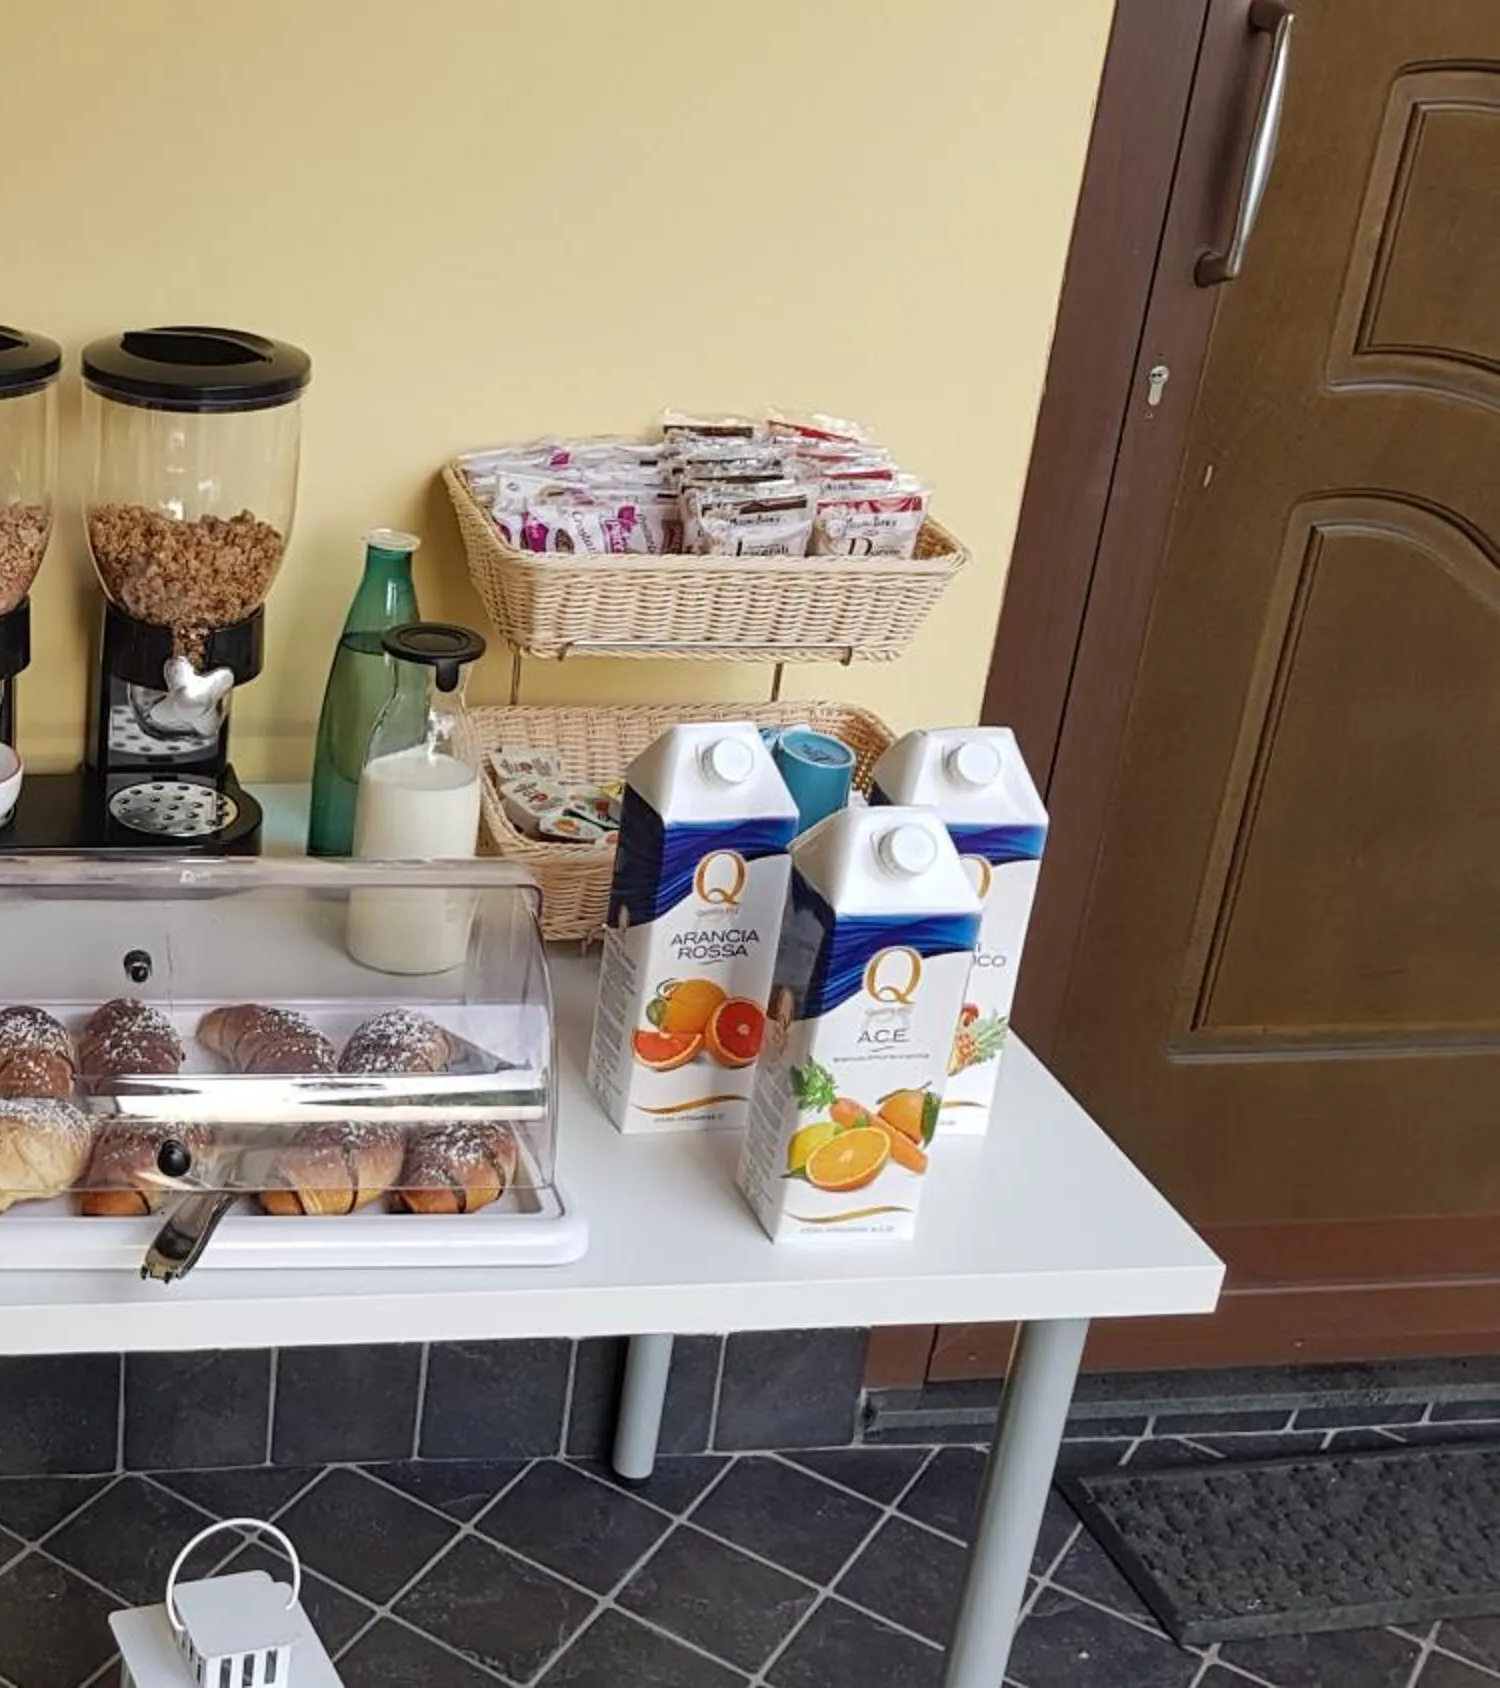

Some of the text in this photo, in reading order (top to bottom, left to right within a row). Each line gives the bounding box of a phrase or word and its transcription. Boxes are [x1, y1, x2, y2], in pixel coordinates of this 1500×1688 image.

[695, 850, 745, 905] Q
[670, 928, 760, 946] ARANCIA
[677, 943, 749, 960] ROSSA
[866, 946, 921, 1005] Q
[856, 1027, 910, 1043] ACE
